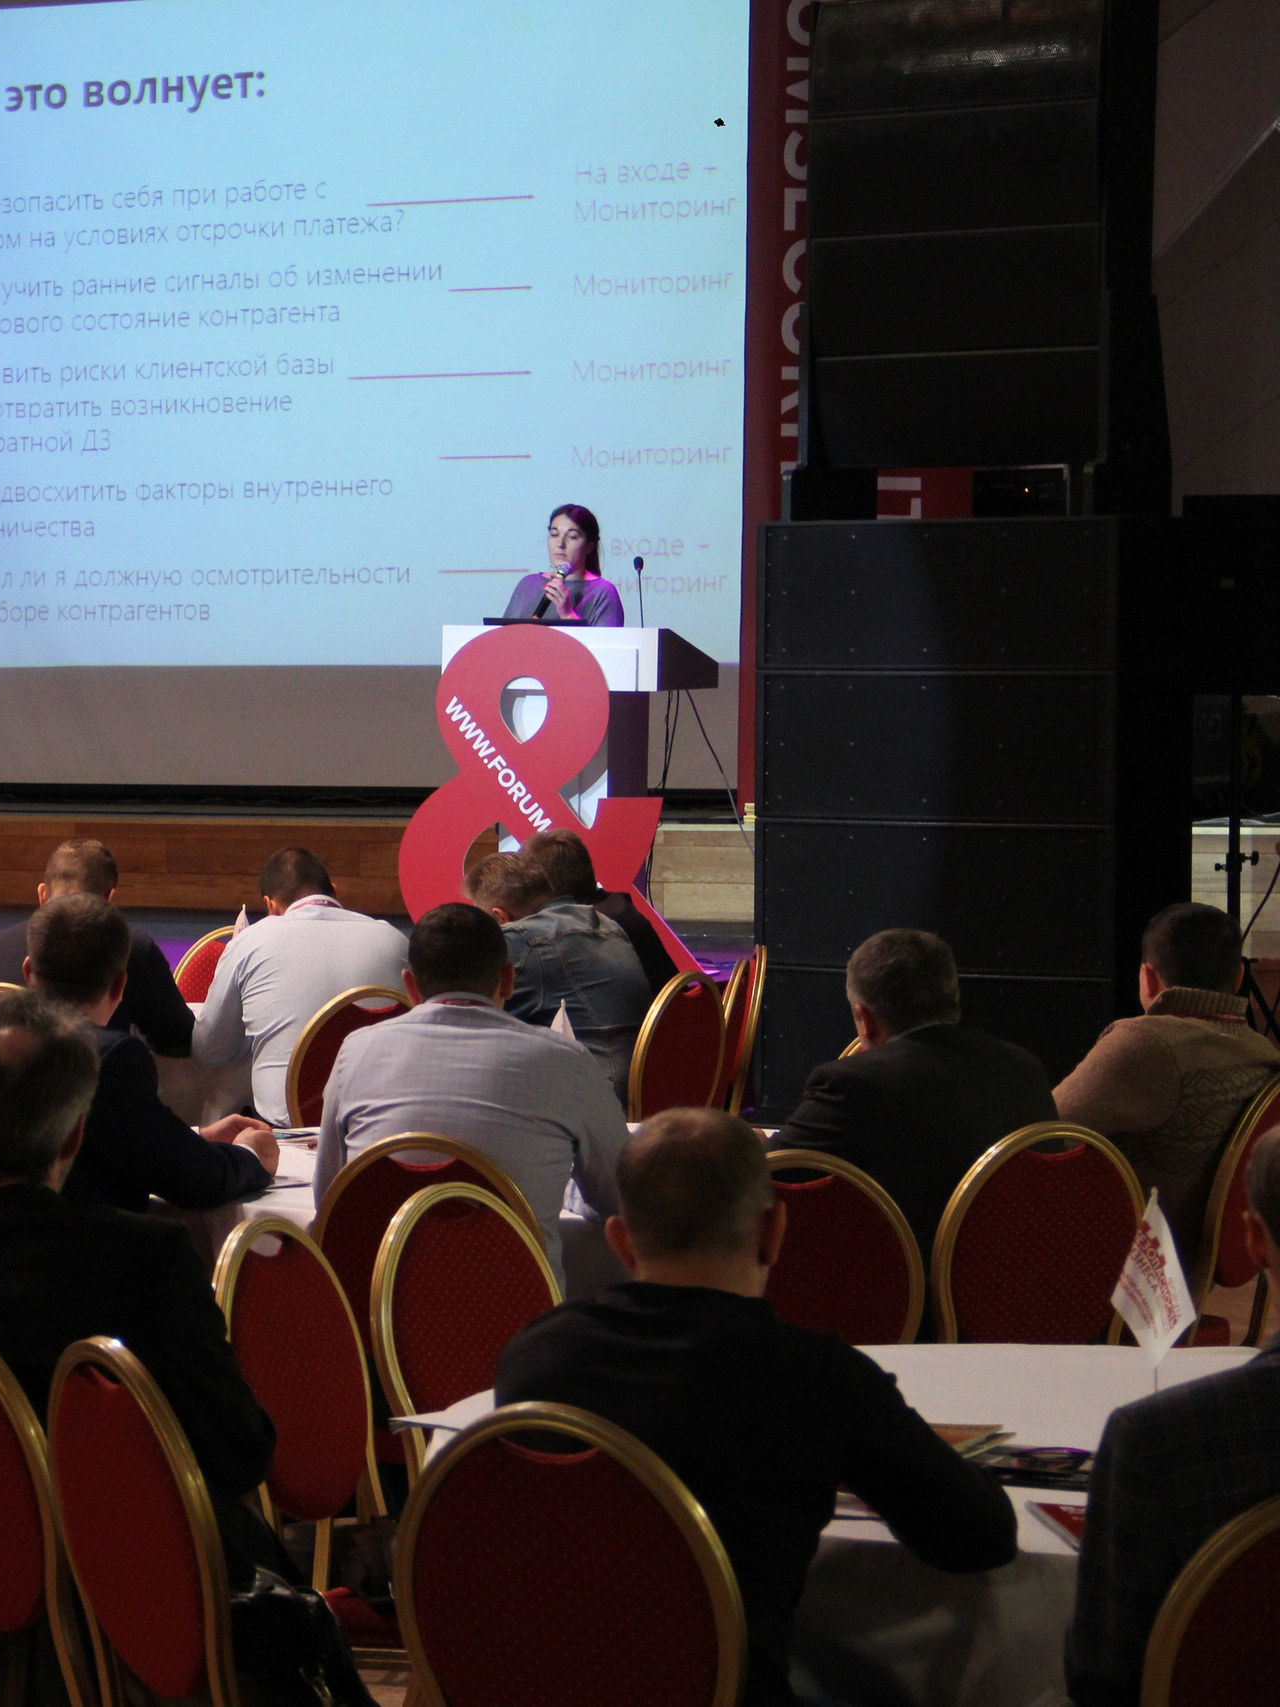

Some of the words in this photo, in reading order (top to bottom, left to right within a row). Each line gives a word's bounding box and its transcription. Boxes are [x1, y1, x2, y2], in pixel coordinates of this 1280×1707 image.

[4, 83, 68, 112] это
[82, 71, 265, 114] волнует:
[574, 161, 608, 185] На
[616, 161, 691, 185] входе
[112, 184, 163, 209] себя
[172, 187, 216, 211] при
[225, 179, 307, 210] работе
[314, 181, 327, 200] с
[574, 196, 737, 226] Мониторинг
[29, 229, 56, 249] на
[63, 224, 169, 254] условиях
[176, 219, 284, 247] отсрочки
[293, 208, 405, 238] платежа?
[71, 275, 157, 302] ранние
[164, 271, 260, 293] сигналы
[268, 264, 299, 289] об
[306, 263, 443, 287] изменении
[572, 271, 734, 300] Мониторинг
[70, 310, 191, 333] состояние
[198, 304, 341, 331] контрагента
[59, 363, 126, 389] риски
[135, 352, 267, 381] клиентской
[276, 352, 334, 376] базы
[571, 358, 732, 387] Мониторинг
[110, 394, 292, 417] возникновение
[571, 443, 732, 473] Мониторинг
[135, 478, 234, 507] факторы
[243, 477, 394, 505] внутреннего
[610, 537, 685, 558] входе
[19, 569, 47, 589] ли
[55, 569, 66, 587] я
[73, 568, 183, 594] должную
[190, 565, 411, 593] осмотрительности
[608, 574, 728, 602] ниторинг
[57, 603, 211, 628] контрагентов
[444, 695, 553, 833] WWW.FORUM
